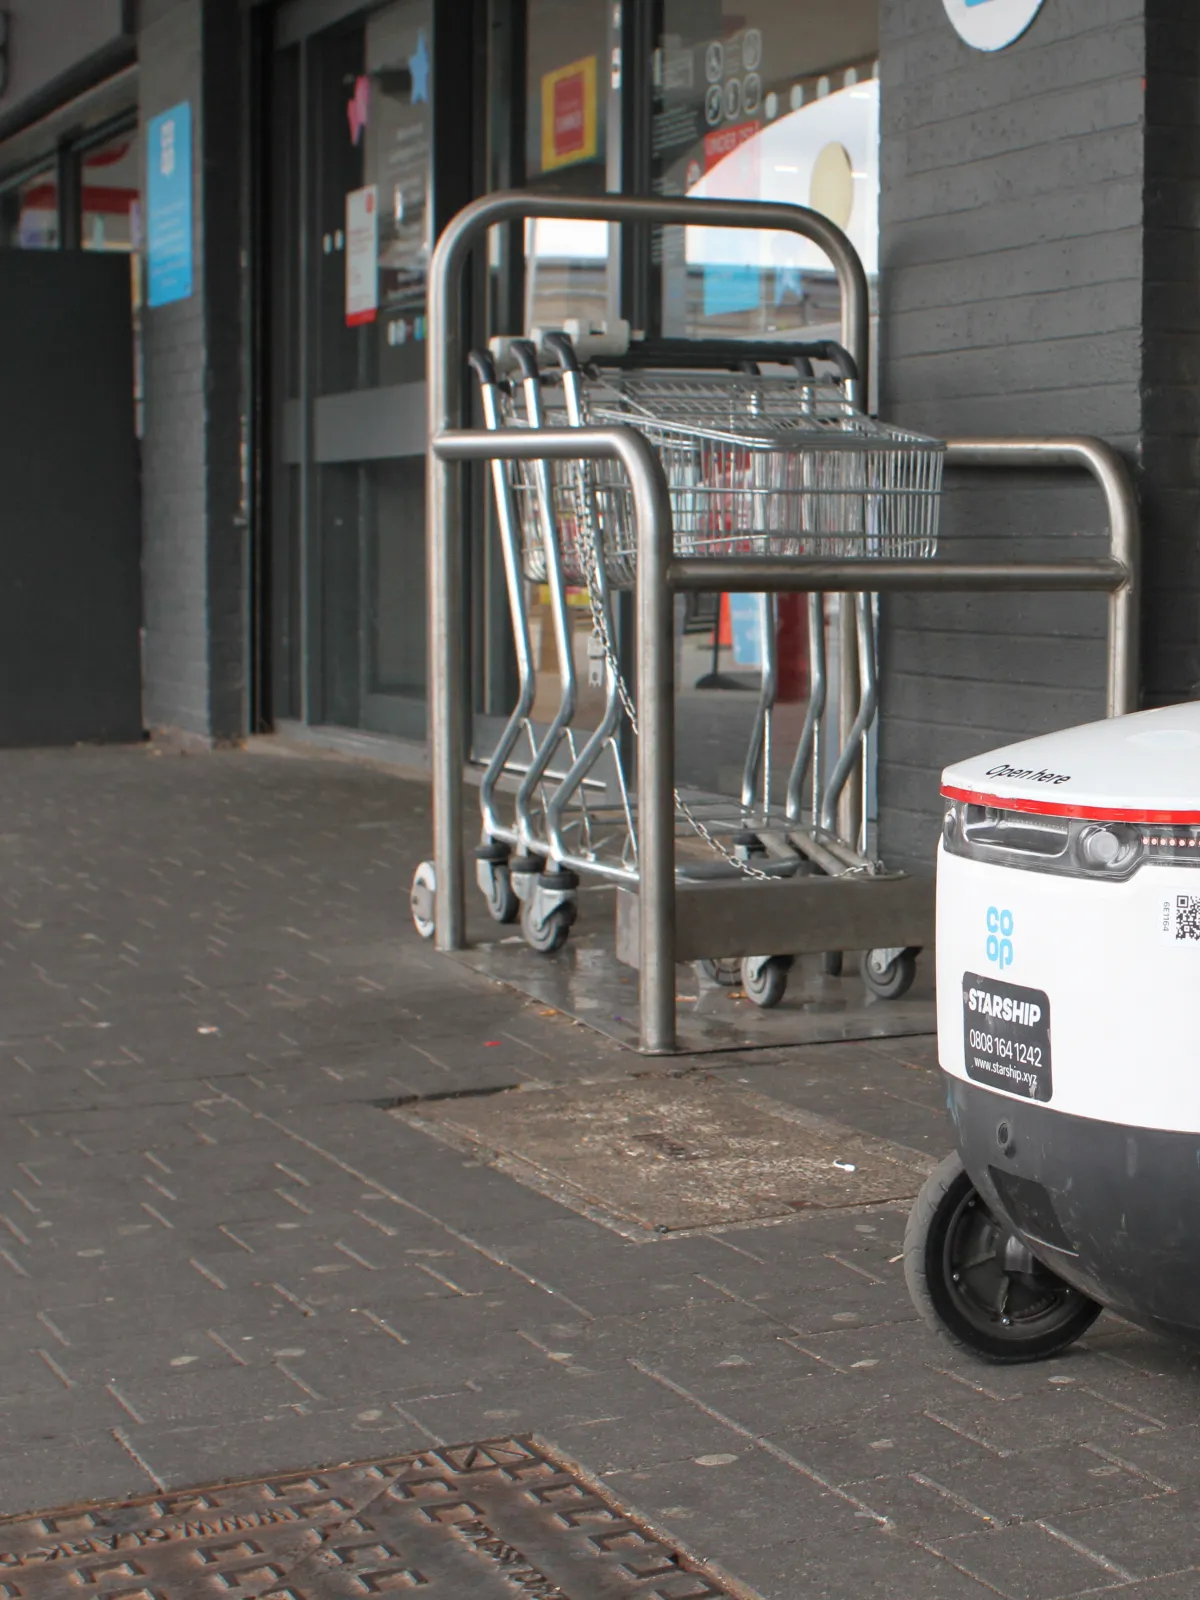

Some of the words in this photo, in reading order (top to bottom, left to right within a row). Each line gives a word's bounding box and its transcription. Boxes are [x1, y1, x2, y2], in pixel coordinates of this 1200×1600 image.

[986, 764, 1033, 779] Open
[1031, 768, 1071, 785] here
[968, 988, 1041, 1027] STARSHIP
[969, 1029, 993, 1053] 0808
[994, 1036, 1013, 1059] 164
[1014, 1043, 1043, 1068] 1242
[974, 1056, 1038, 1086] www.starship.xyz
